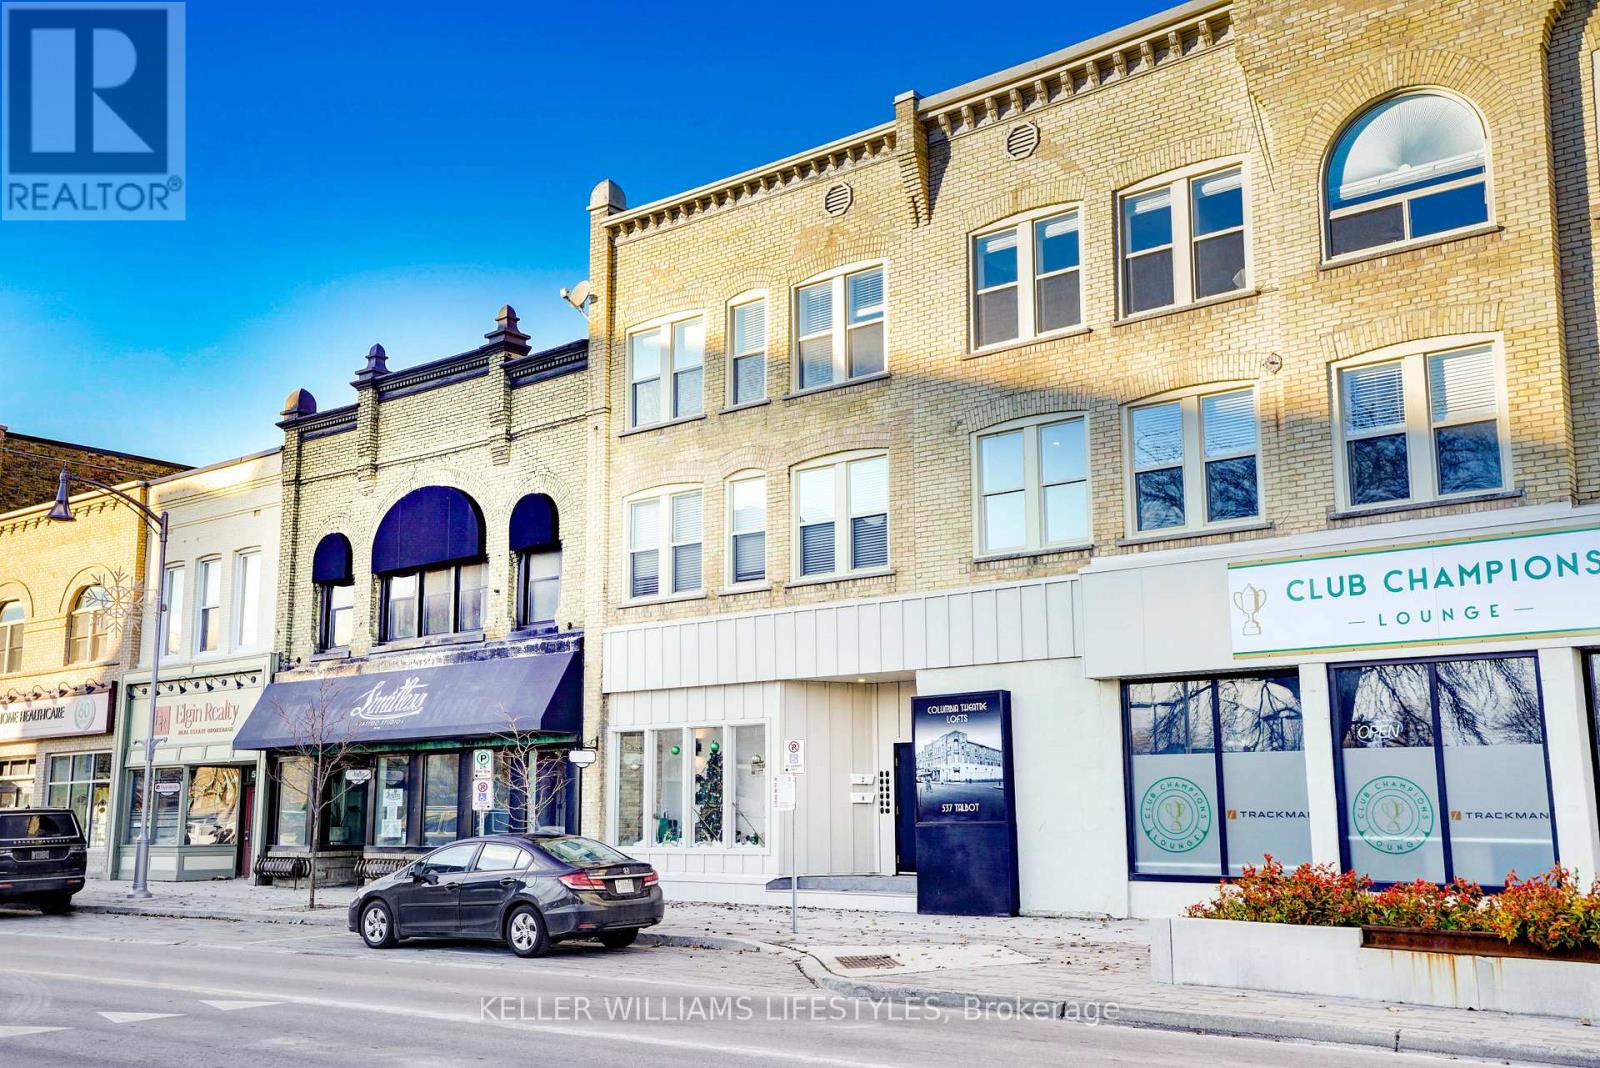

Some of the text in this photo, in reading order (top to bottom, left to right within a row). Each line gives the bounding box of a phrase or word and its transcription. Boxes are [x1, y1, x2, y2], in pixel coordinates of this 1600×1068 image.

[1286, 550, 1600, 602] CLUB CHAMPIONS
[1379, 604, 1500, 626] LOUNGE
[20, 706, 65, 722] HEALTHCARE
[176, 703, 202, 728] Elgin
[204, 700, 239, 725] Realty
[928, 702, 987, 714] COLUMBIA THEATRE
[946, 714, 968, 724] LOFTS
[1357, 724, 1400, 739] OPEN
[941, 802, 979, 813] 537 TALBOT
[1145, 781, 1207, 820] CLUB CHAMPIONS
[1357, 781, 1429, 821] CLUB CHAMPIONS
[1465, 811, 1549, 819] TRACKMAN
[1153, 833, 1201, 850] LOUNGE
